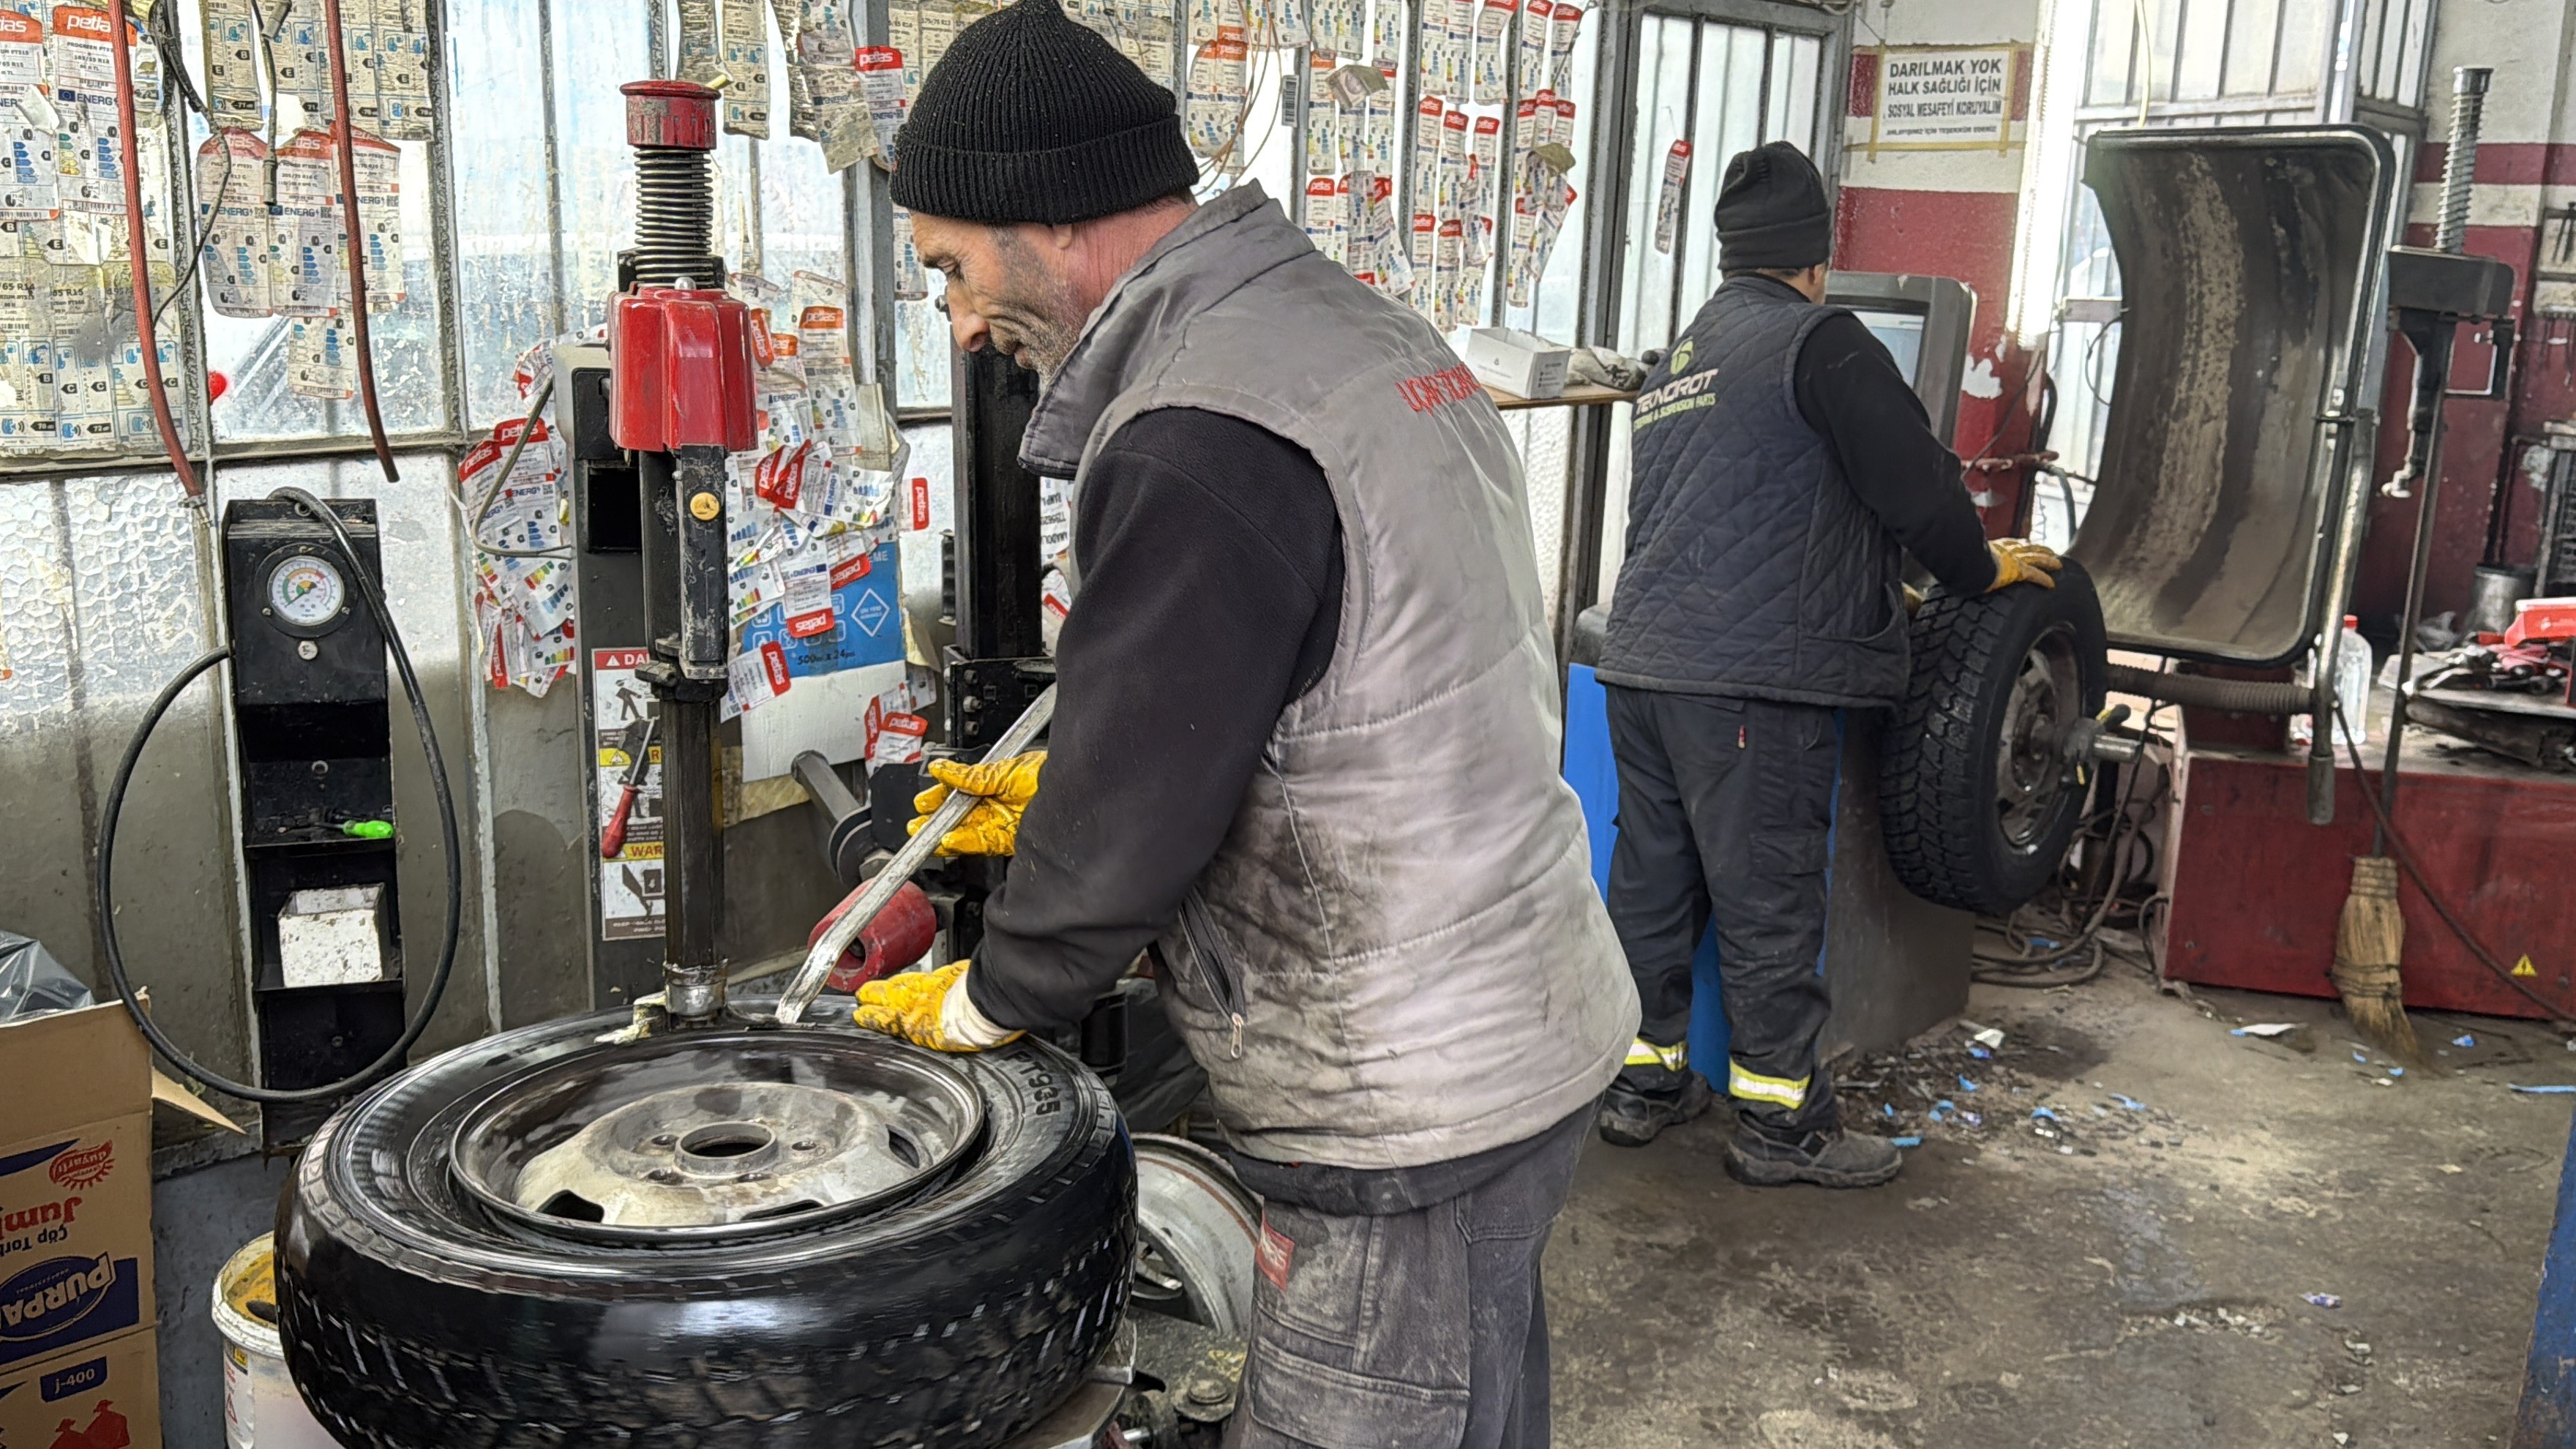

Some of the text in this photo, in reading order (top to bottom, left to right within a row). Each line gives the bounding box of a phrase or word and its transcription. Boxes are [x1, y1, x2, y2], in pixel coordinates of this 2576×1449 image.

[1890, 59, 2002, 78] DARILMAK YOK
[1888, 75, 2001, 96] HALK SAĞLIĞI İÇİN
[1887, 97, 2002, 118] SOSYAL MESAFEYİ KORUYALIM
[284, 206, 316, 217] ENERG
[806, 310, 836, 323] petlas
[785, 462, 799, 501] petlas
[795, 613, 827, 632] petlas
[766, 650, 785, 686] petlas
[37, 1223, 68, 1246] Çöp
[54, 1368, 95, 1394] j-400
